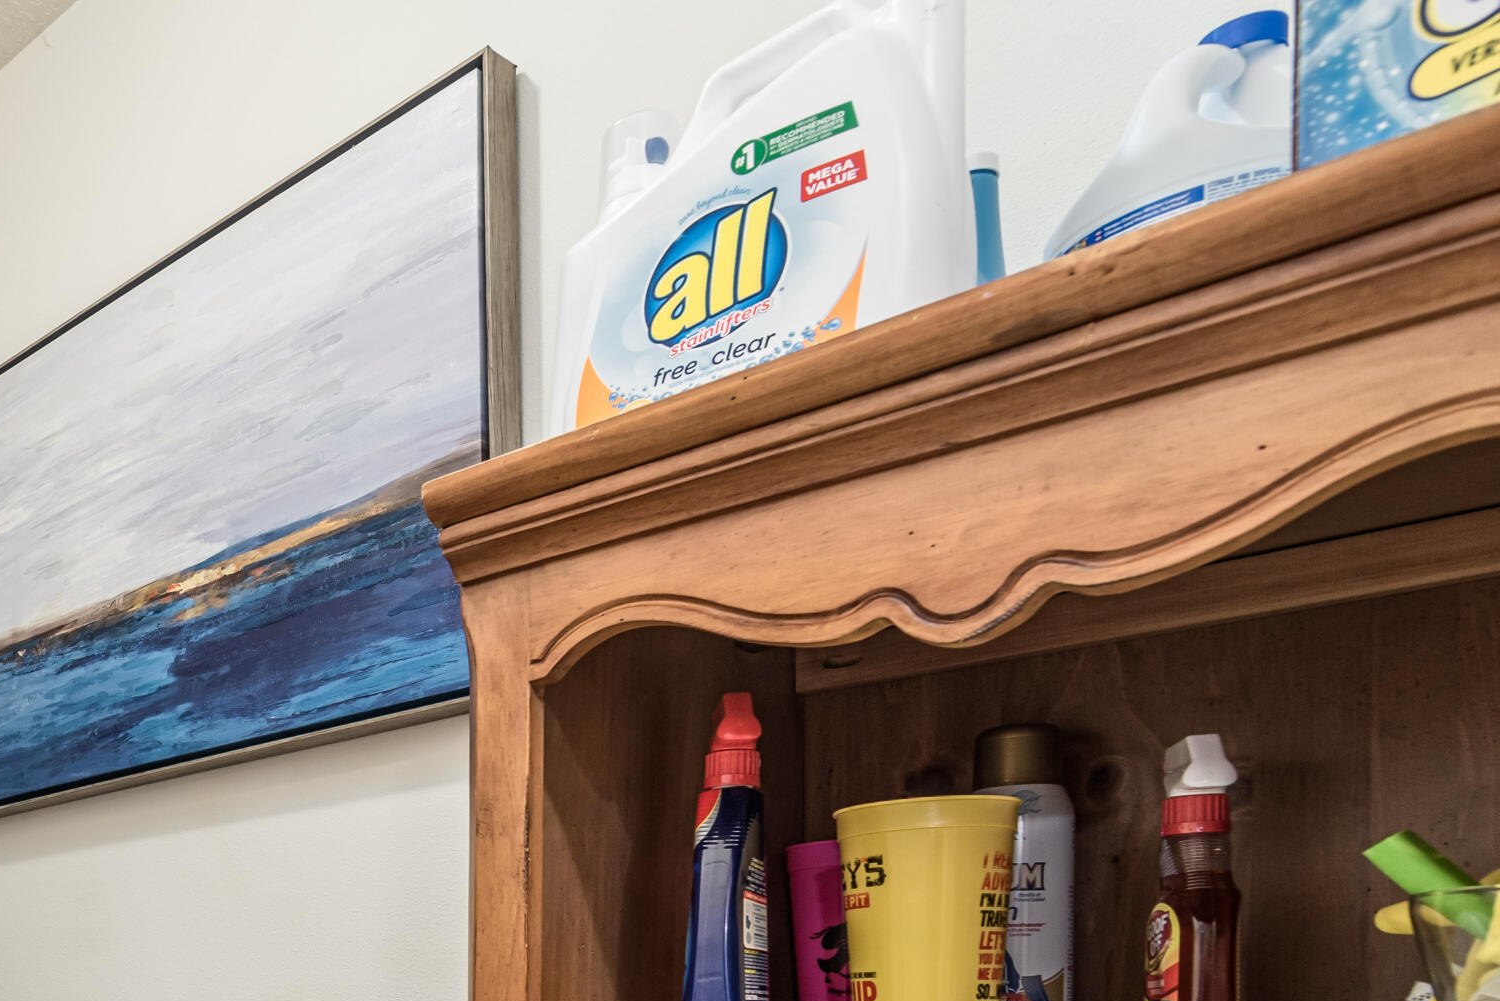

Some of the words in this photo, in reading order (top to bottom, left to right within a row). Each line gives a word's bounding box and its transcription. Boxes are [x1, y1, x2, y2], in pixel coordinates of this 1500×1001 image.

[734, 141, 755, 170] #1
[808, 158, 855, 184] MEGA
[805, 168, 857, 195] VALUE
[649, 187, 777, 344] all
[669, 299, 772, 357] stainlifters
[654, 360, 698, 387] free
[711, 333, 776, 365] clear
